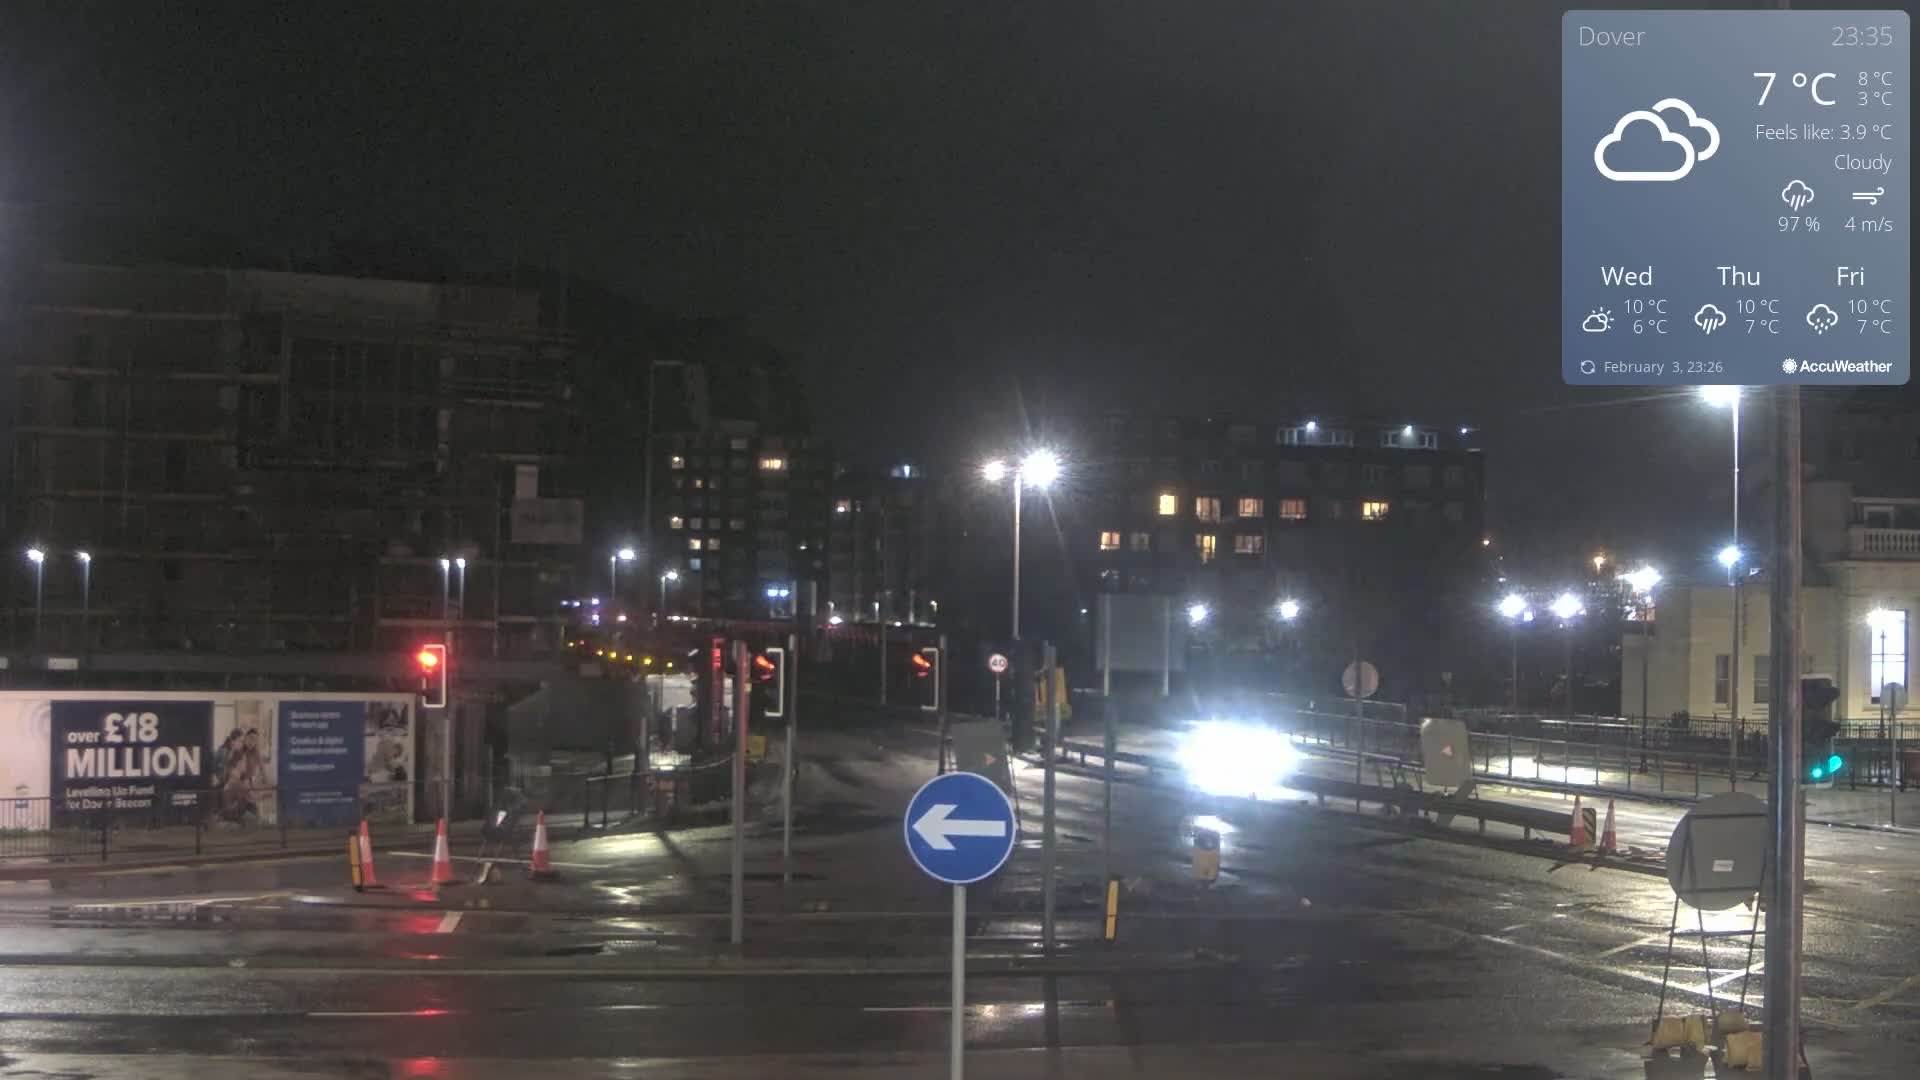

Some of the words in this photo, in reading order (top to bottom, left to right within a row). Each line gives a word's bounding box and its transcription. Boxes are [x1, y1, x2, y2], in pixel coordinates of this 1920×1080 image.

[992, 658, 1005, 667] 40
[67, 731, 100, 743] over
[104, 711, 159, 743] £18
[66, 746, 201, 778] MILLION
[82, 799, 112, 810] Dovr
